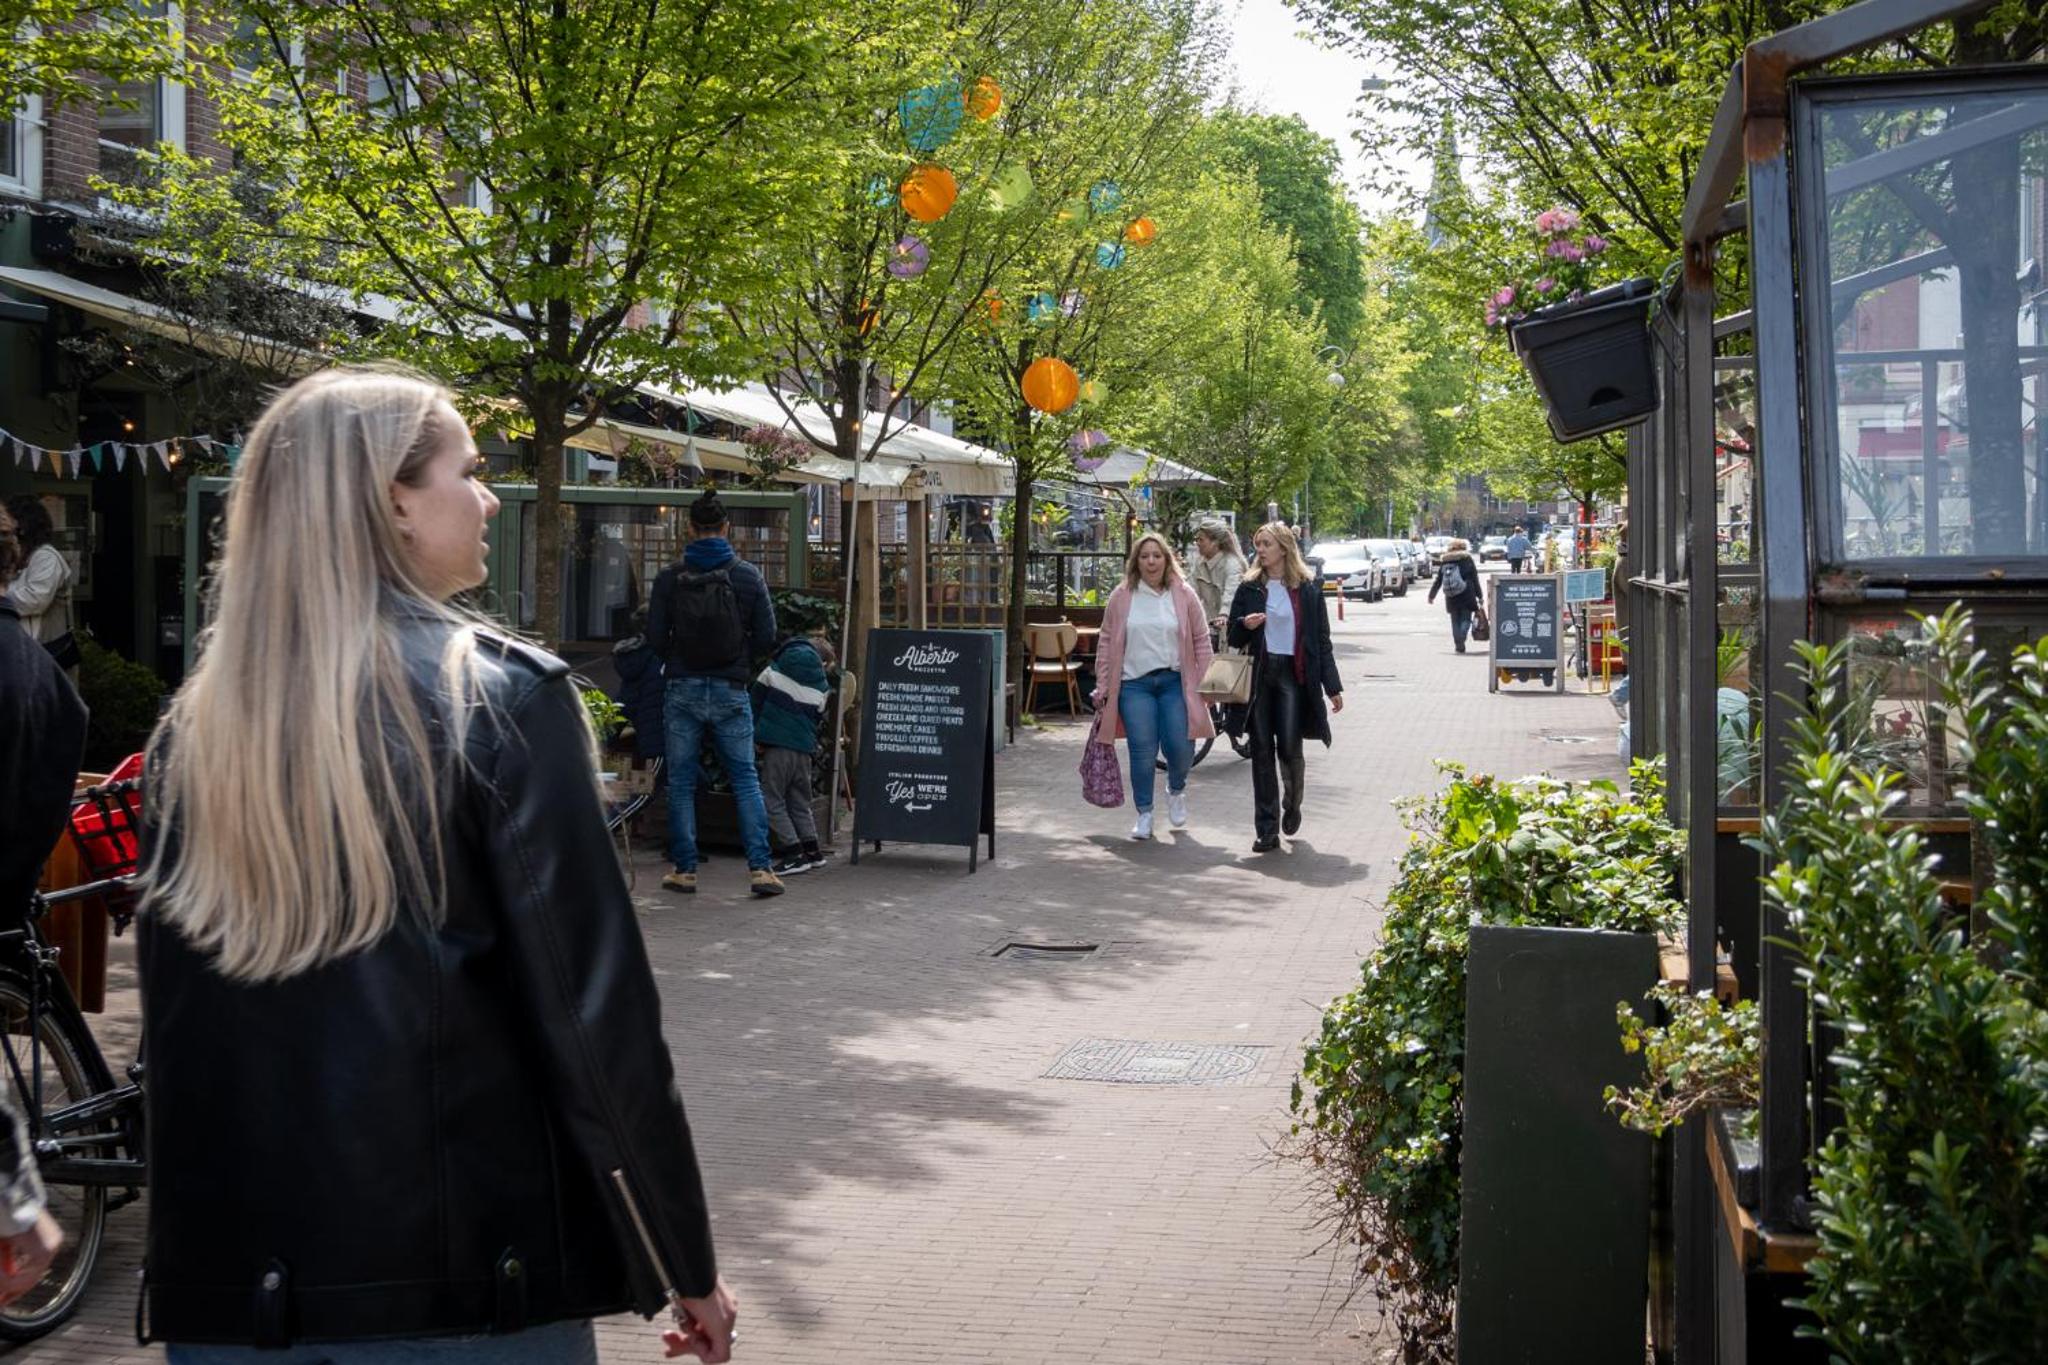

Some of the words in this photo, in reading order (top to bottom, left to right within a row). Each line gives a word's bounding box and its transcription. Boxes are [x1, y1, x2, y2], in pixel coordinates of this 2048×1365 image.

[893, 645, 959, 670] Alberto
[878, 681, 897, 692] DAILY
[897, 683, 920, 692] FRESH
[924, 705, 938, 714] AND
[885, 780, 915, 804] Yes
[917, 784, 948, 794] WE'RE
[916, 793, 948, 801] OPEN
